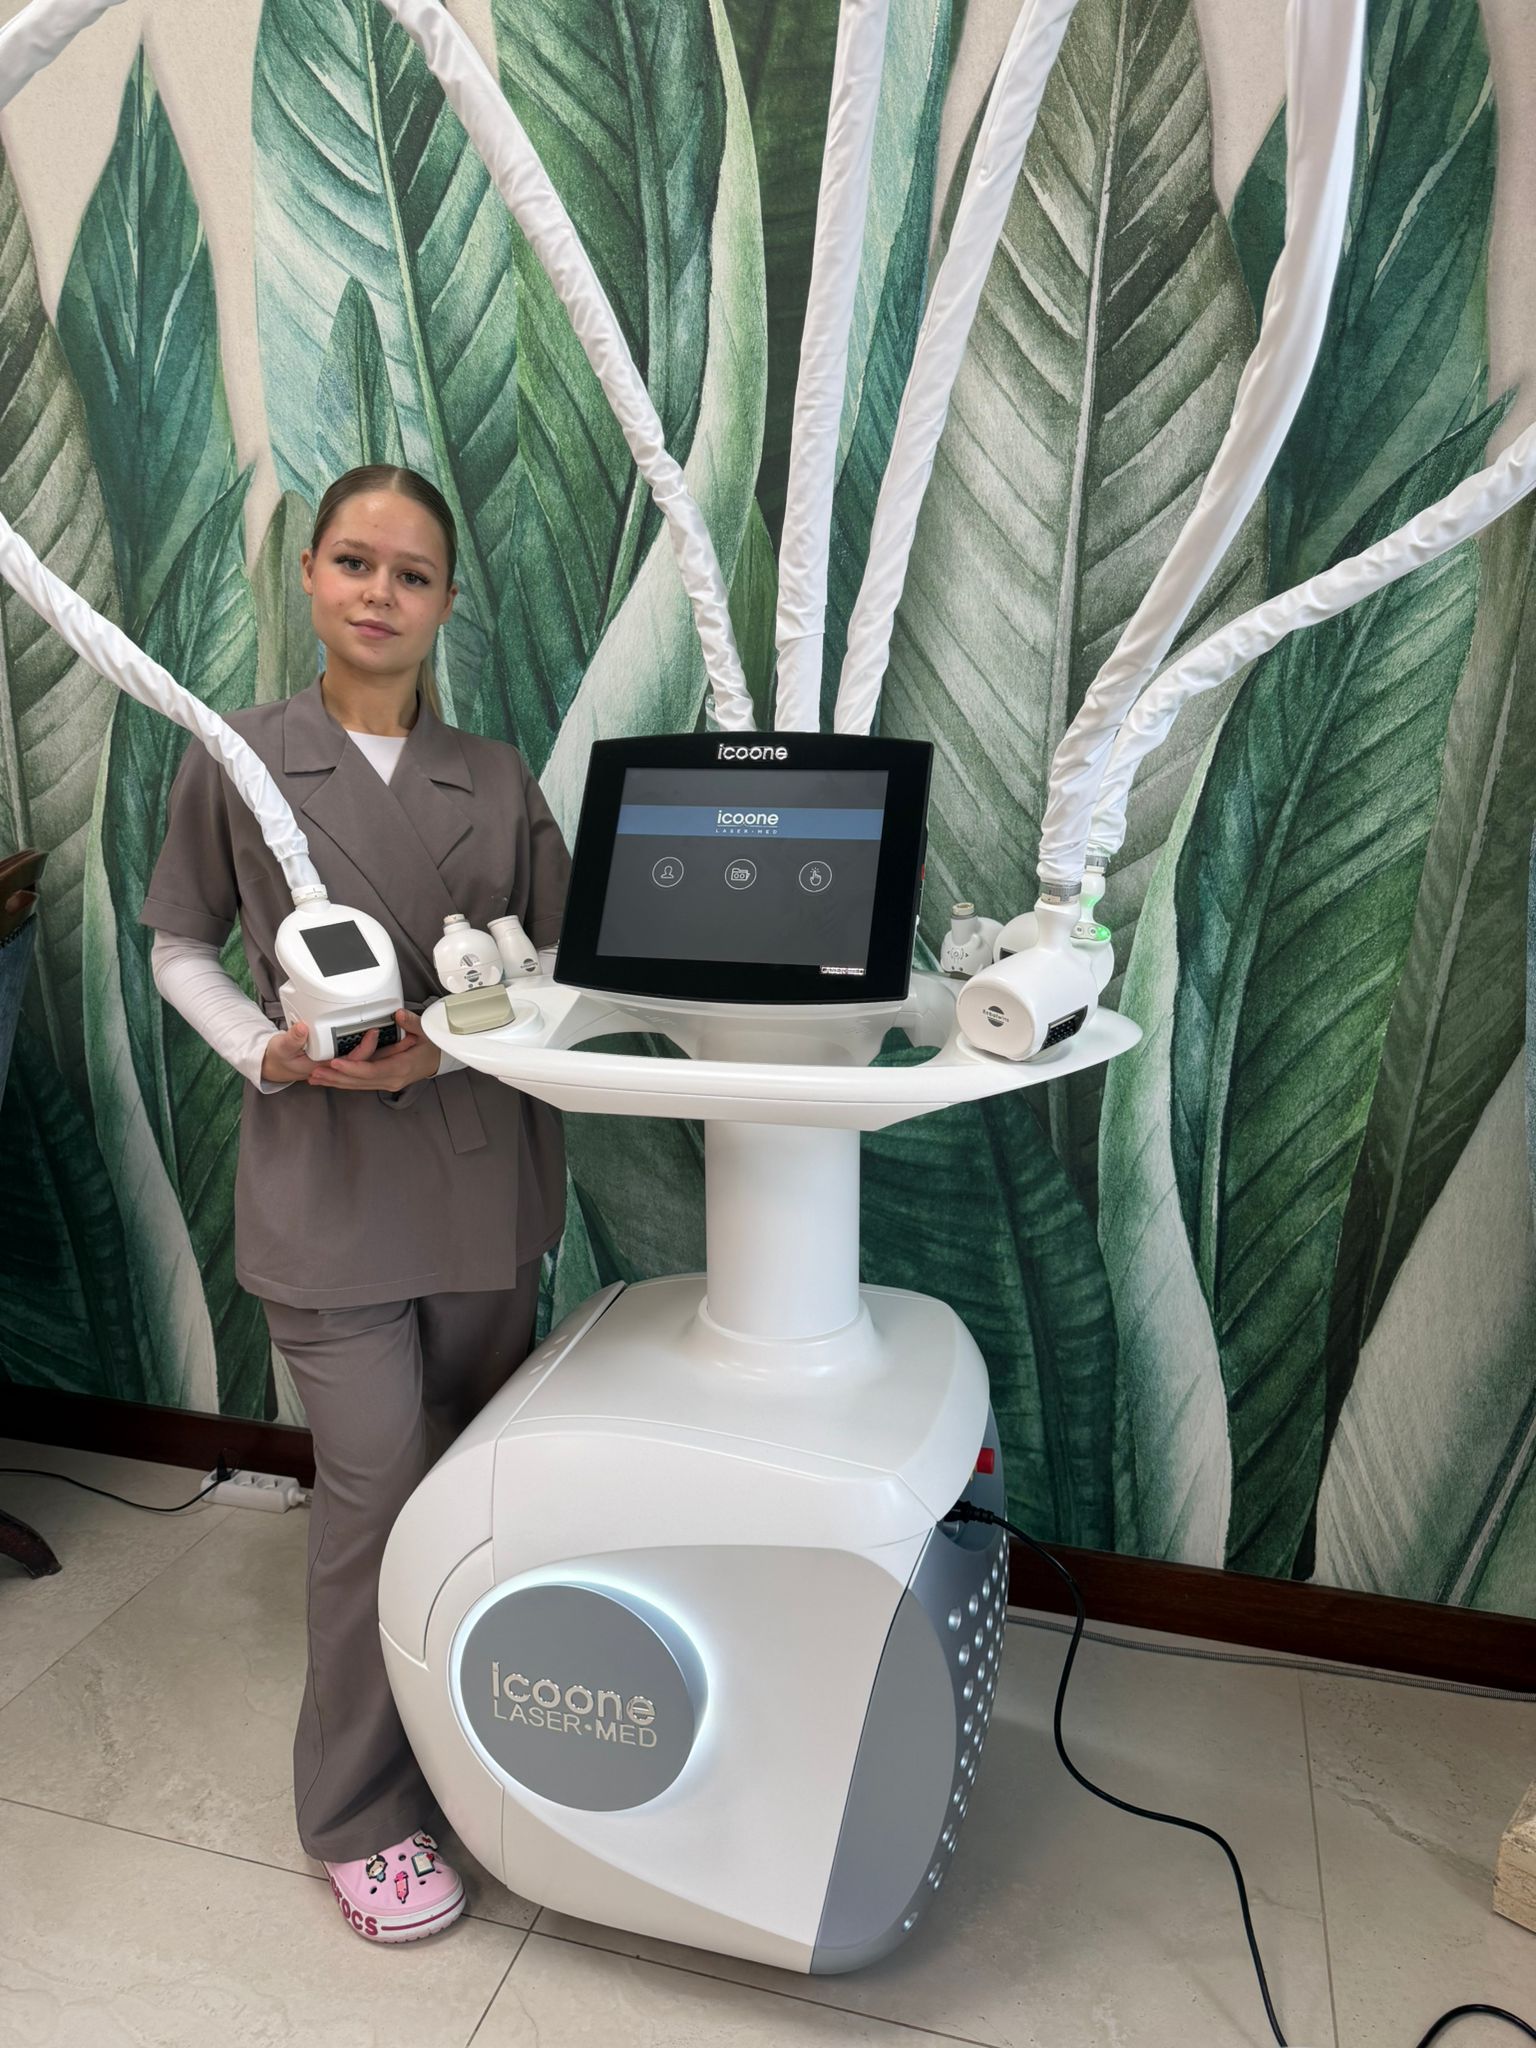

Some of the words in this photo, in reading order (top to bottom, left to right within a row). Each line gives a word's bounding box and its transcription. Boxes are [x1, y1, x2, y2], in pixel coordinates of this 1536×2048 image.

[717, 743, 788, 760] icoone
[717, 809, 779, 826] icoone
[491, 1661, 656, 1726] icoone
